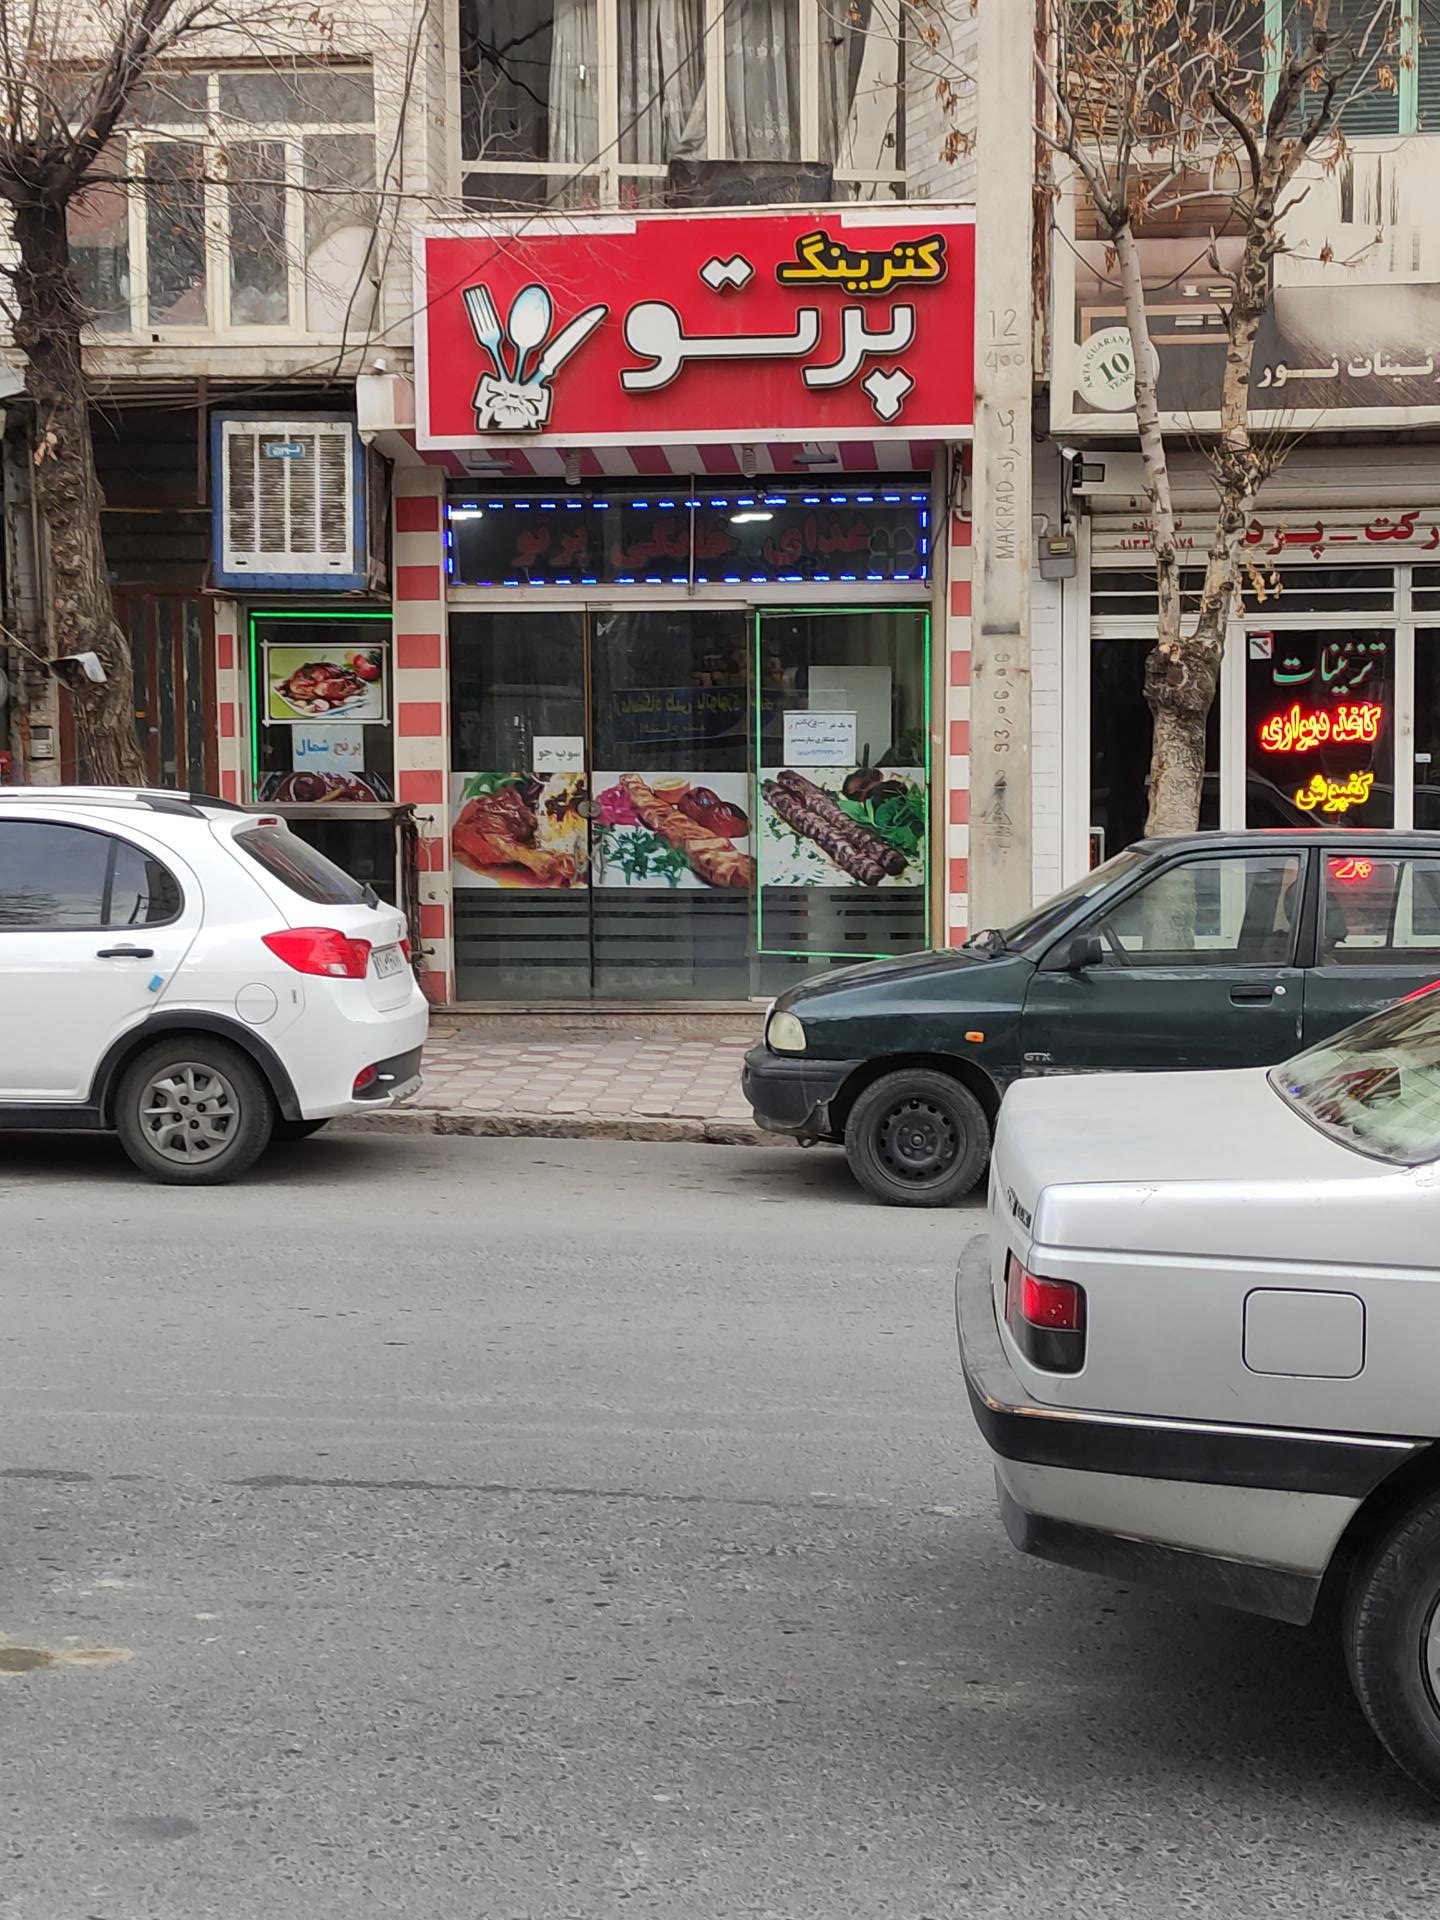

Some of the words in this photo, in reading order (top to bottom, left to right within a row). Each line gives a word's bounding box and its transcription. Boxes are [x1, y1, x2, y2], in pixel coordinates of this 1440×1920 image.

[783, 234, 936, 290] کترینگ
[620, 253, 916, 422] پرتو
[987, 308, 1018, 338] 12
[1097, 352, 1130, 384] 10
[1256, 352, 1340, 388] نور
[995, 480, 1015, 560] MAKRAD
[1272, 642, 1388, 696] تزئینات
[1260, 705, 1331, 751] دیواری
[1332, 704, 1382, 743] کاغذ
[295, 738, 330, 757] شمال
[333, 738, 362, 757] برنج
[1295, 772, 1375, 812] کفپوش
